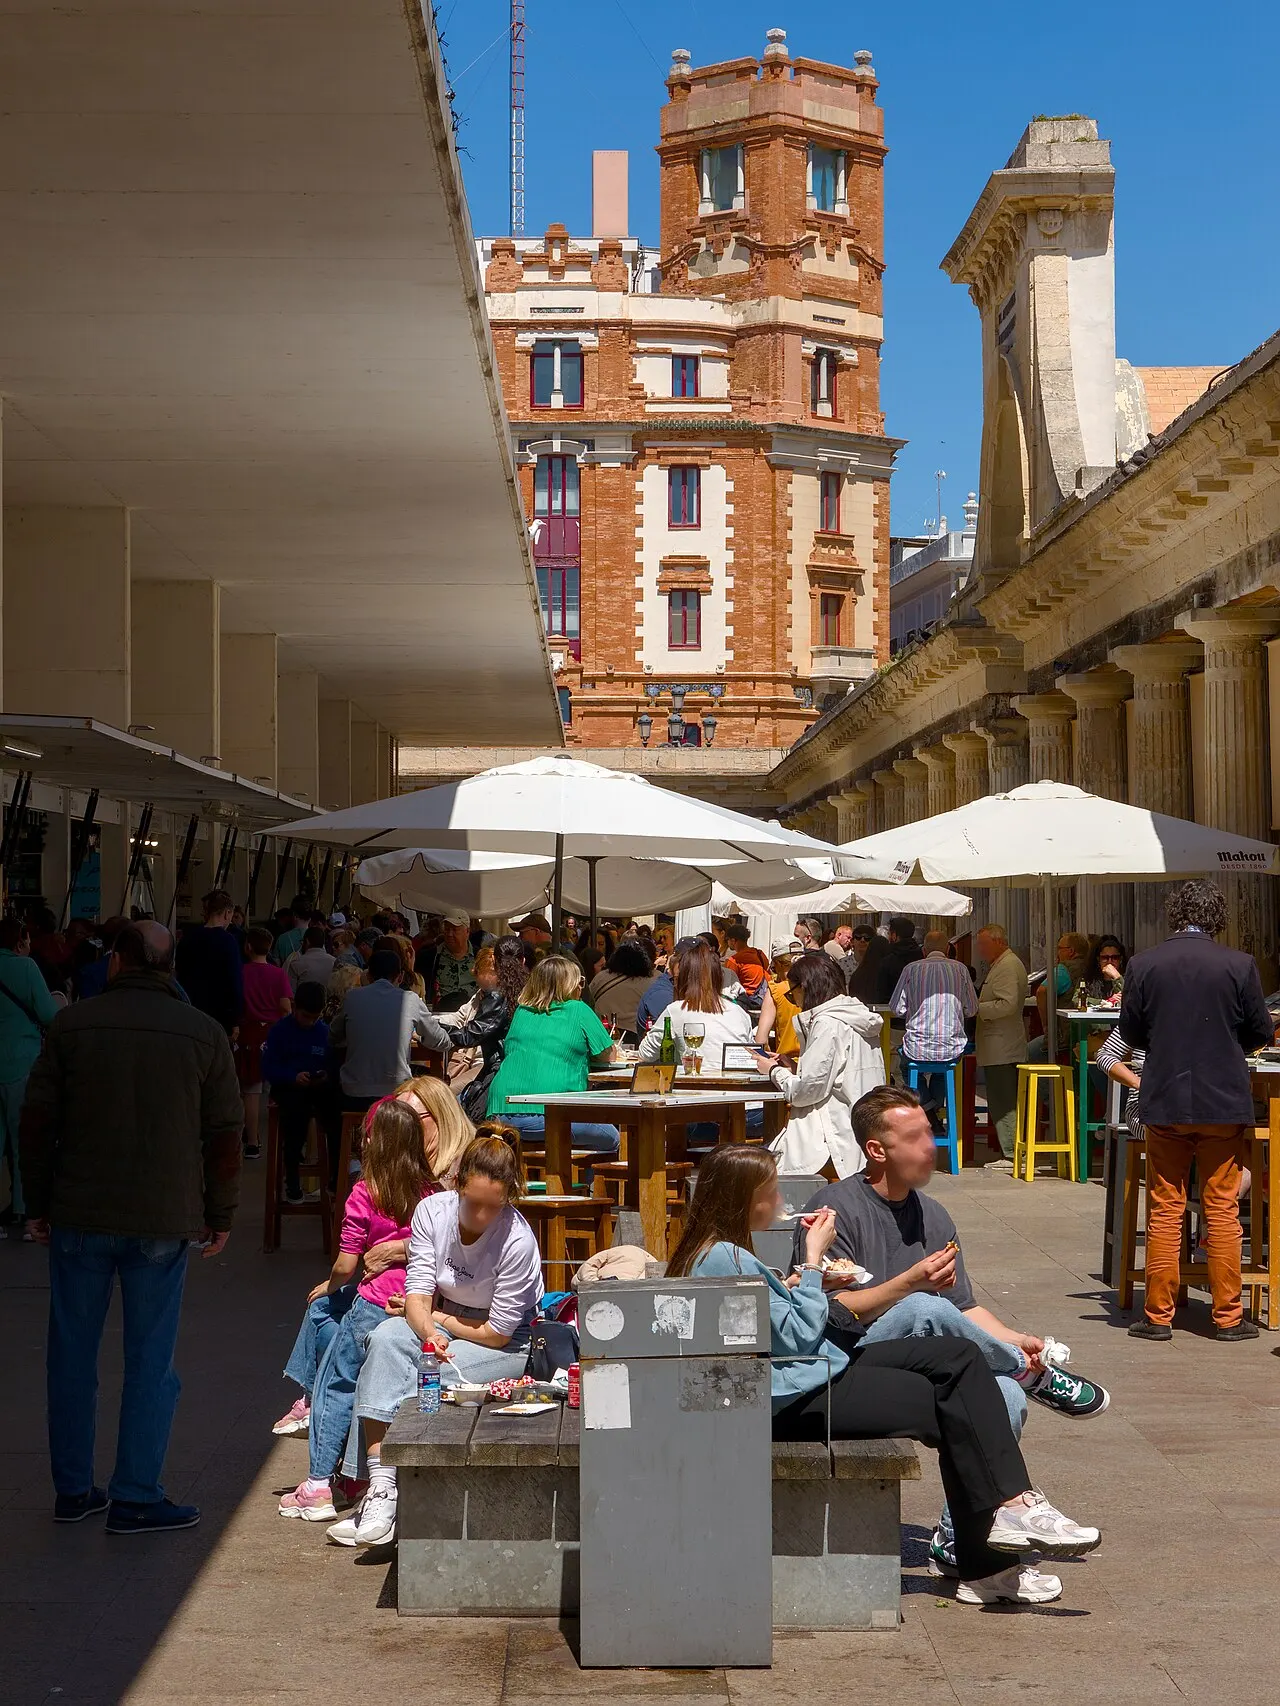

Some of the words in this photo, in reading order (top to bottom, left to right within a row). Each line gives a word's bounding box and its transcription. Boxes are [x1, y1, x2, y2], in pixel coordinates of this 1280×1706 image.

[1216, 850, 1266, 862] Mahou
[444, 1257, 460, 1273] Pepe
[457, 1266, 475, 1280] Jeans
